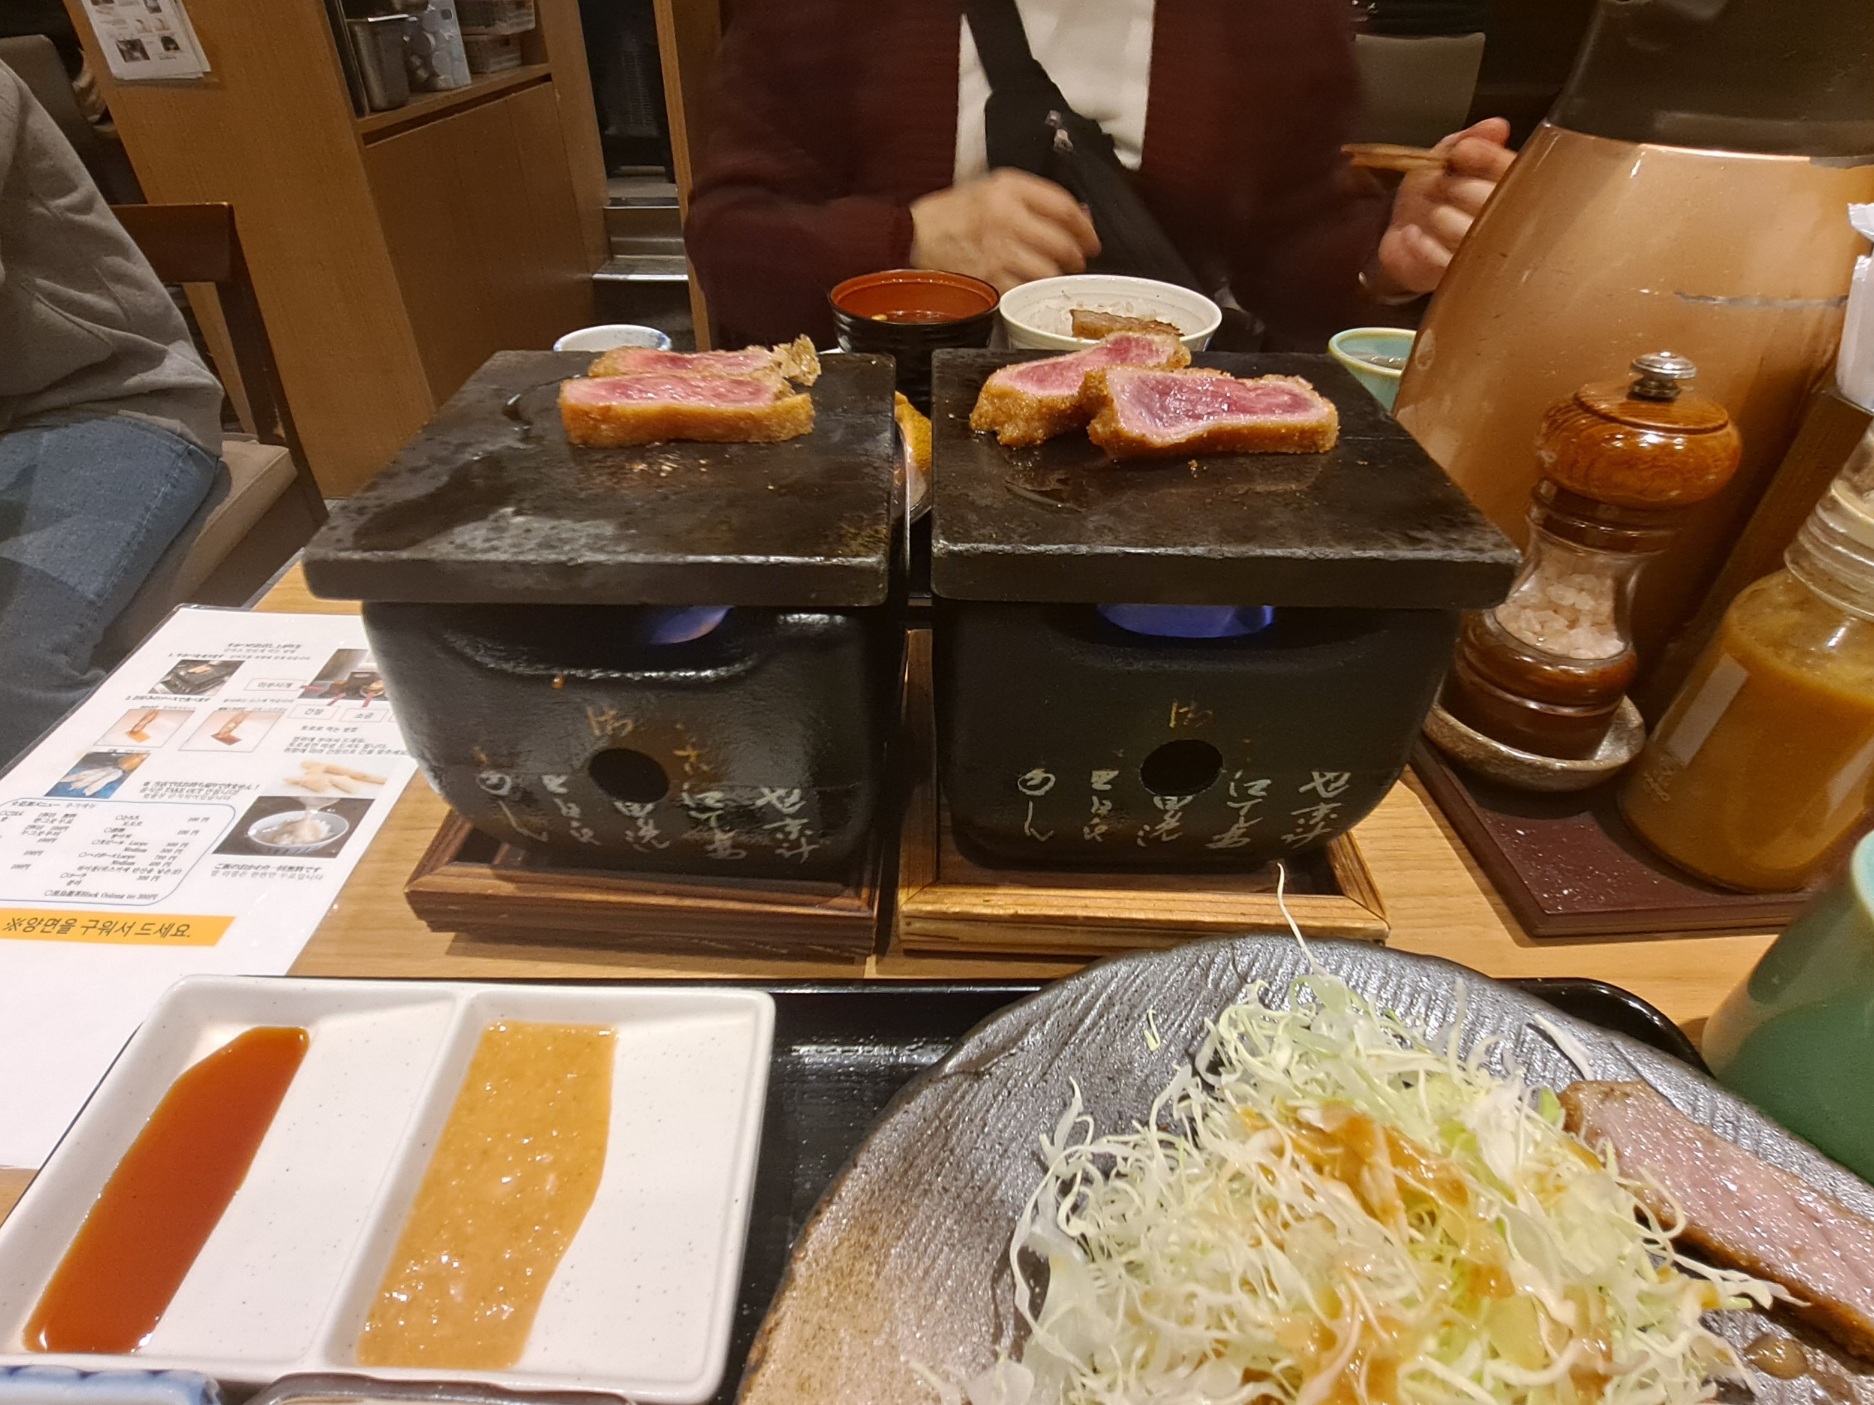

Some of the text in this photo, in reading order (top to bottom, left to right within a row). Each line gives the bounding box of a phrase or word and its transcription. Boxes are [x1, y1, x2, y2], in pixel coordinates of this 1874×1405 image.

[304, 708, 325, 716] 간장
[353, 711, 374, 719] 소금
[80, 918, 136, 938] 구워서
[134, 921, 192, 939] 드세요.
